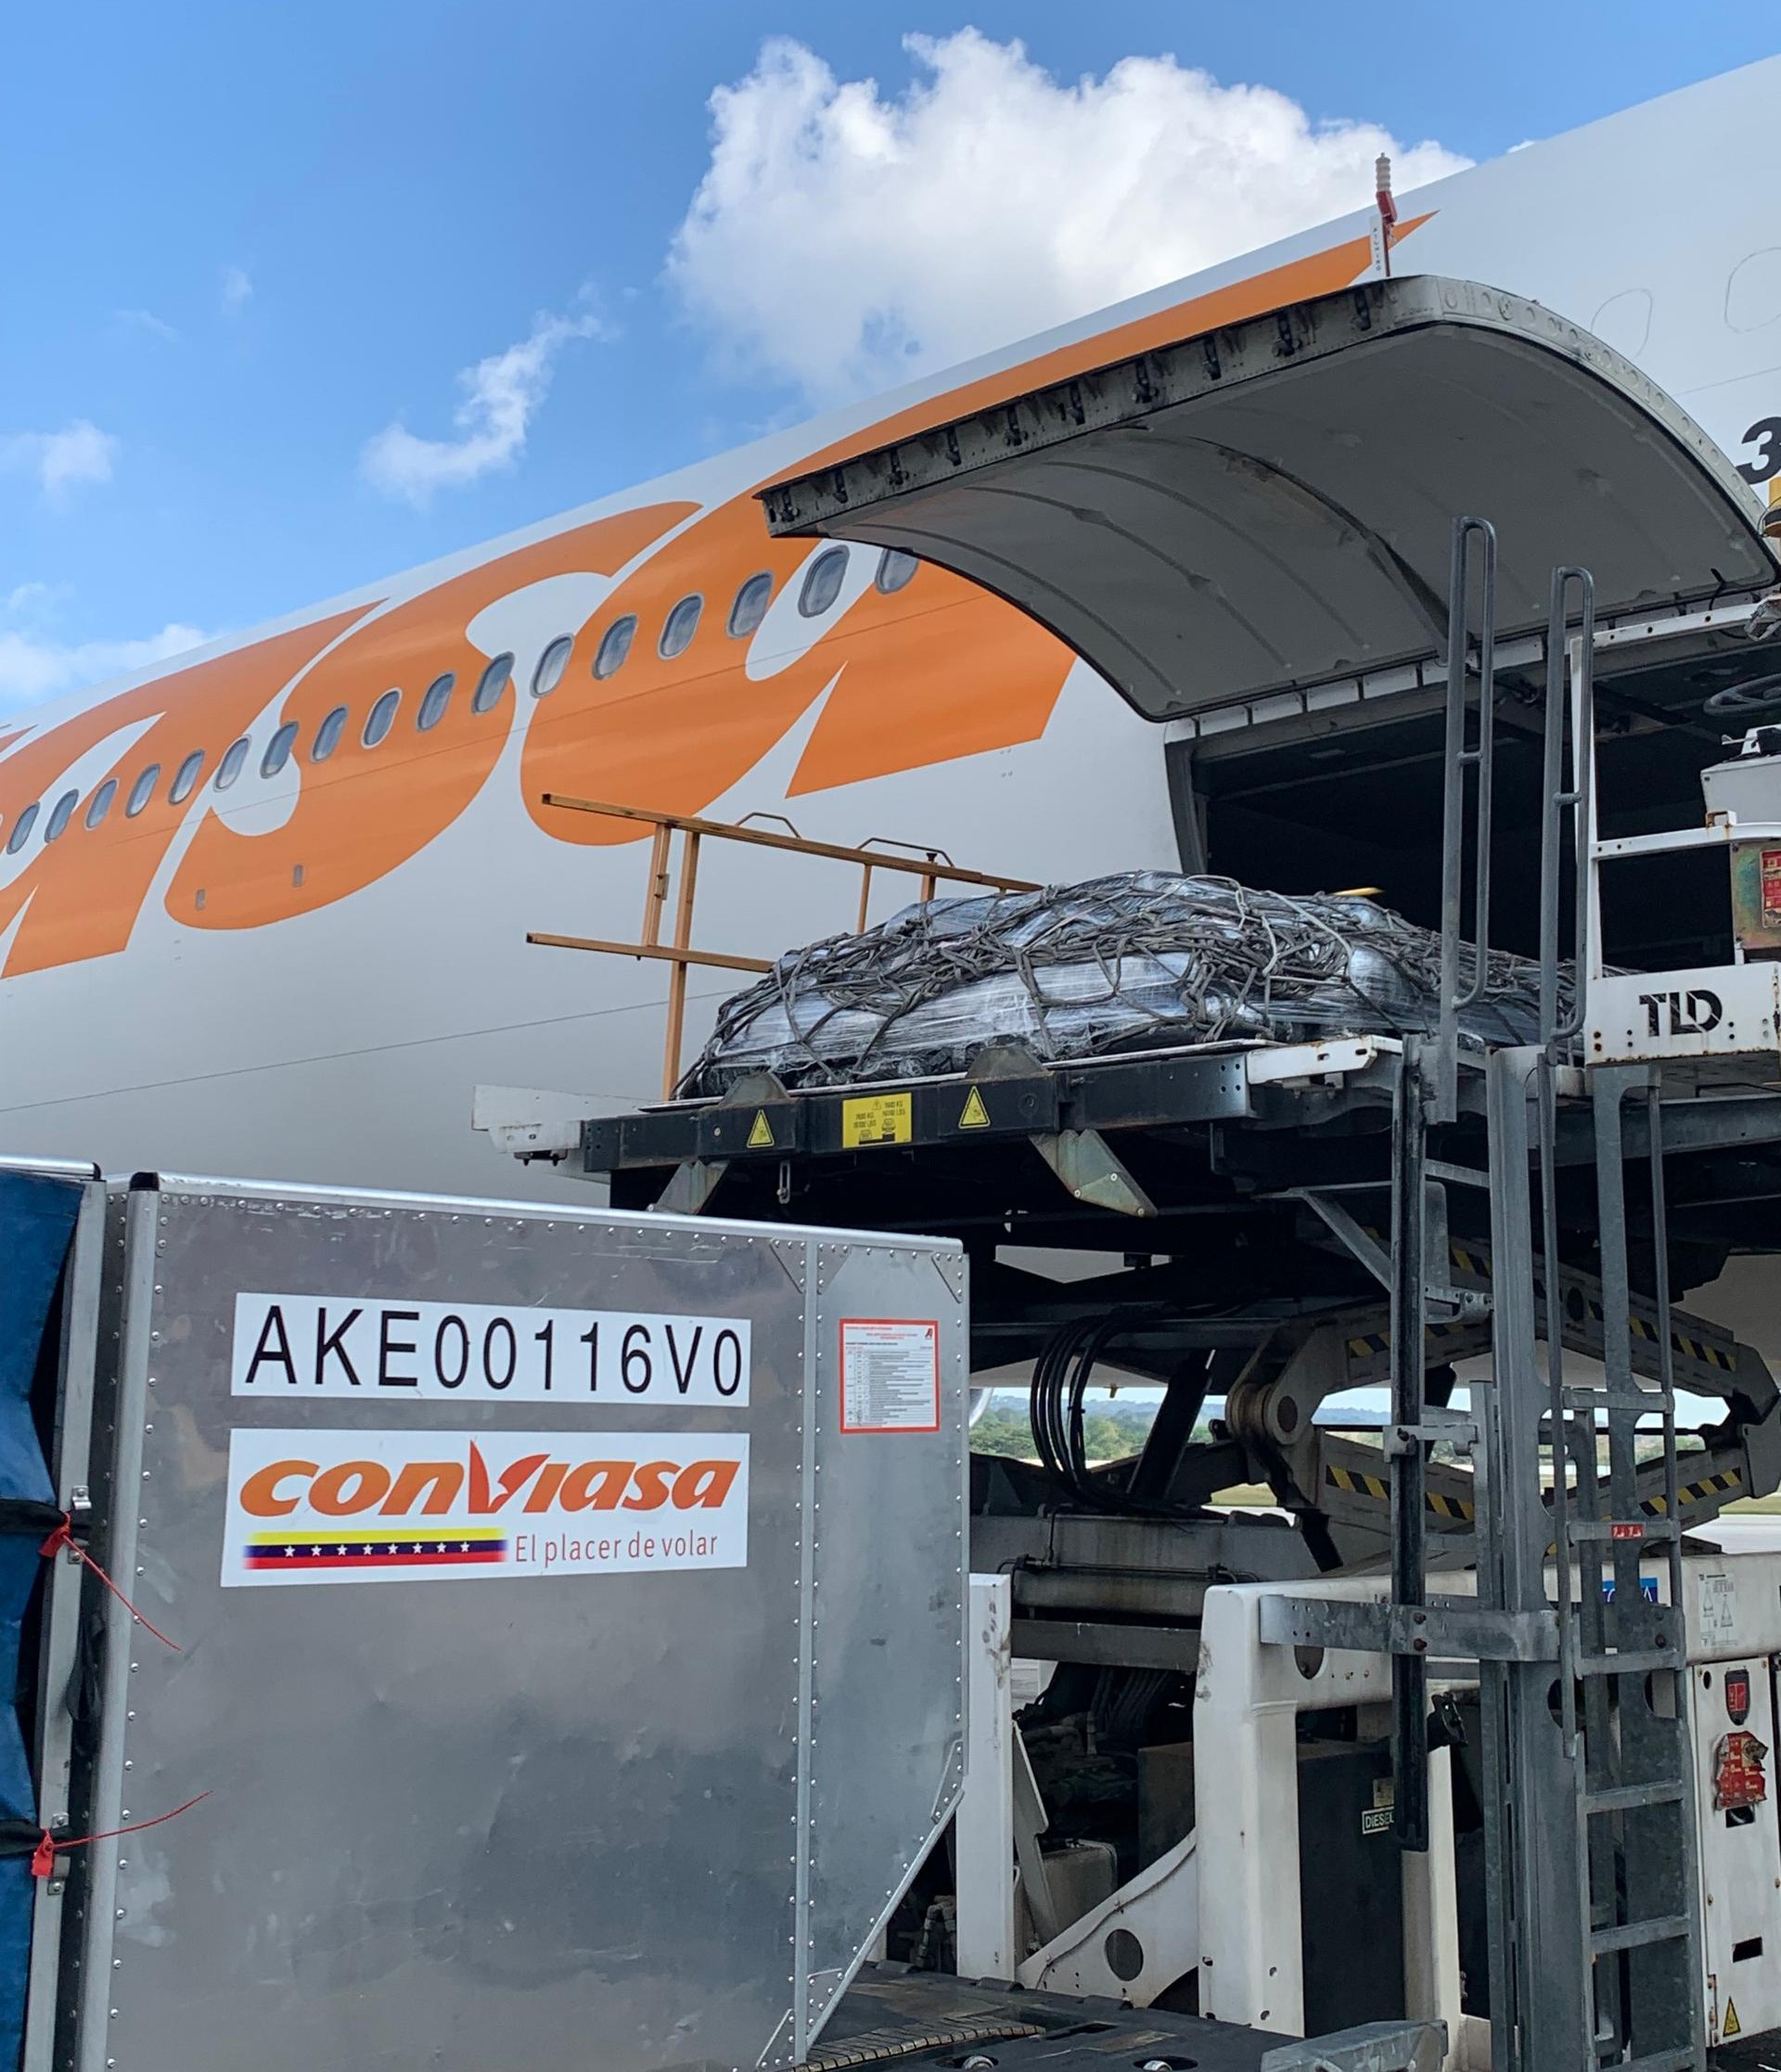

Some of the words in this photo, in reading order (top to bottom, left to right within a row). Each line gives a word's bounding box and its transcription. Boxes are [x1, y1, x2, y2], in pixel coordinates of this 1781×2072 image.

[1639, 989, 1723, 1037] TLD
[246, 1305, 742, 1397] AKE00116V0
[516, 1533, 536, 1563] El
[545, 1532, 621, 1567] placer
[628, 1530, 655, 1558] de
[661, 1528, 718, 1556] volar
[1365, 1812, 1395, 1829] DIESEL
